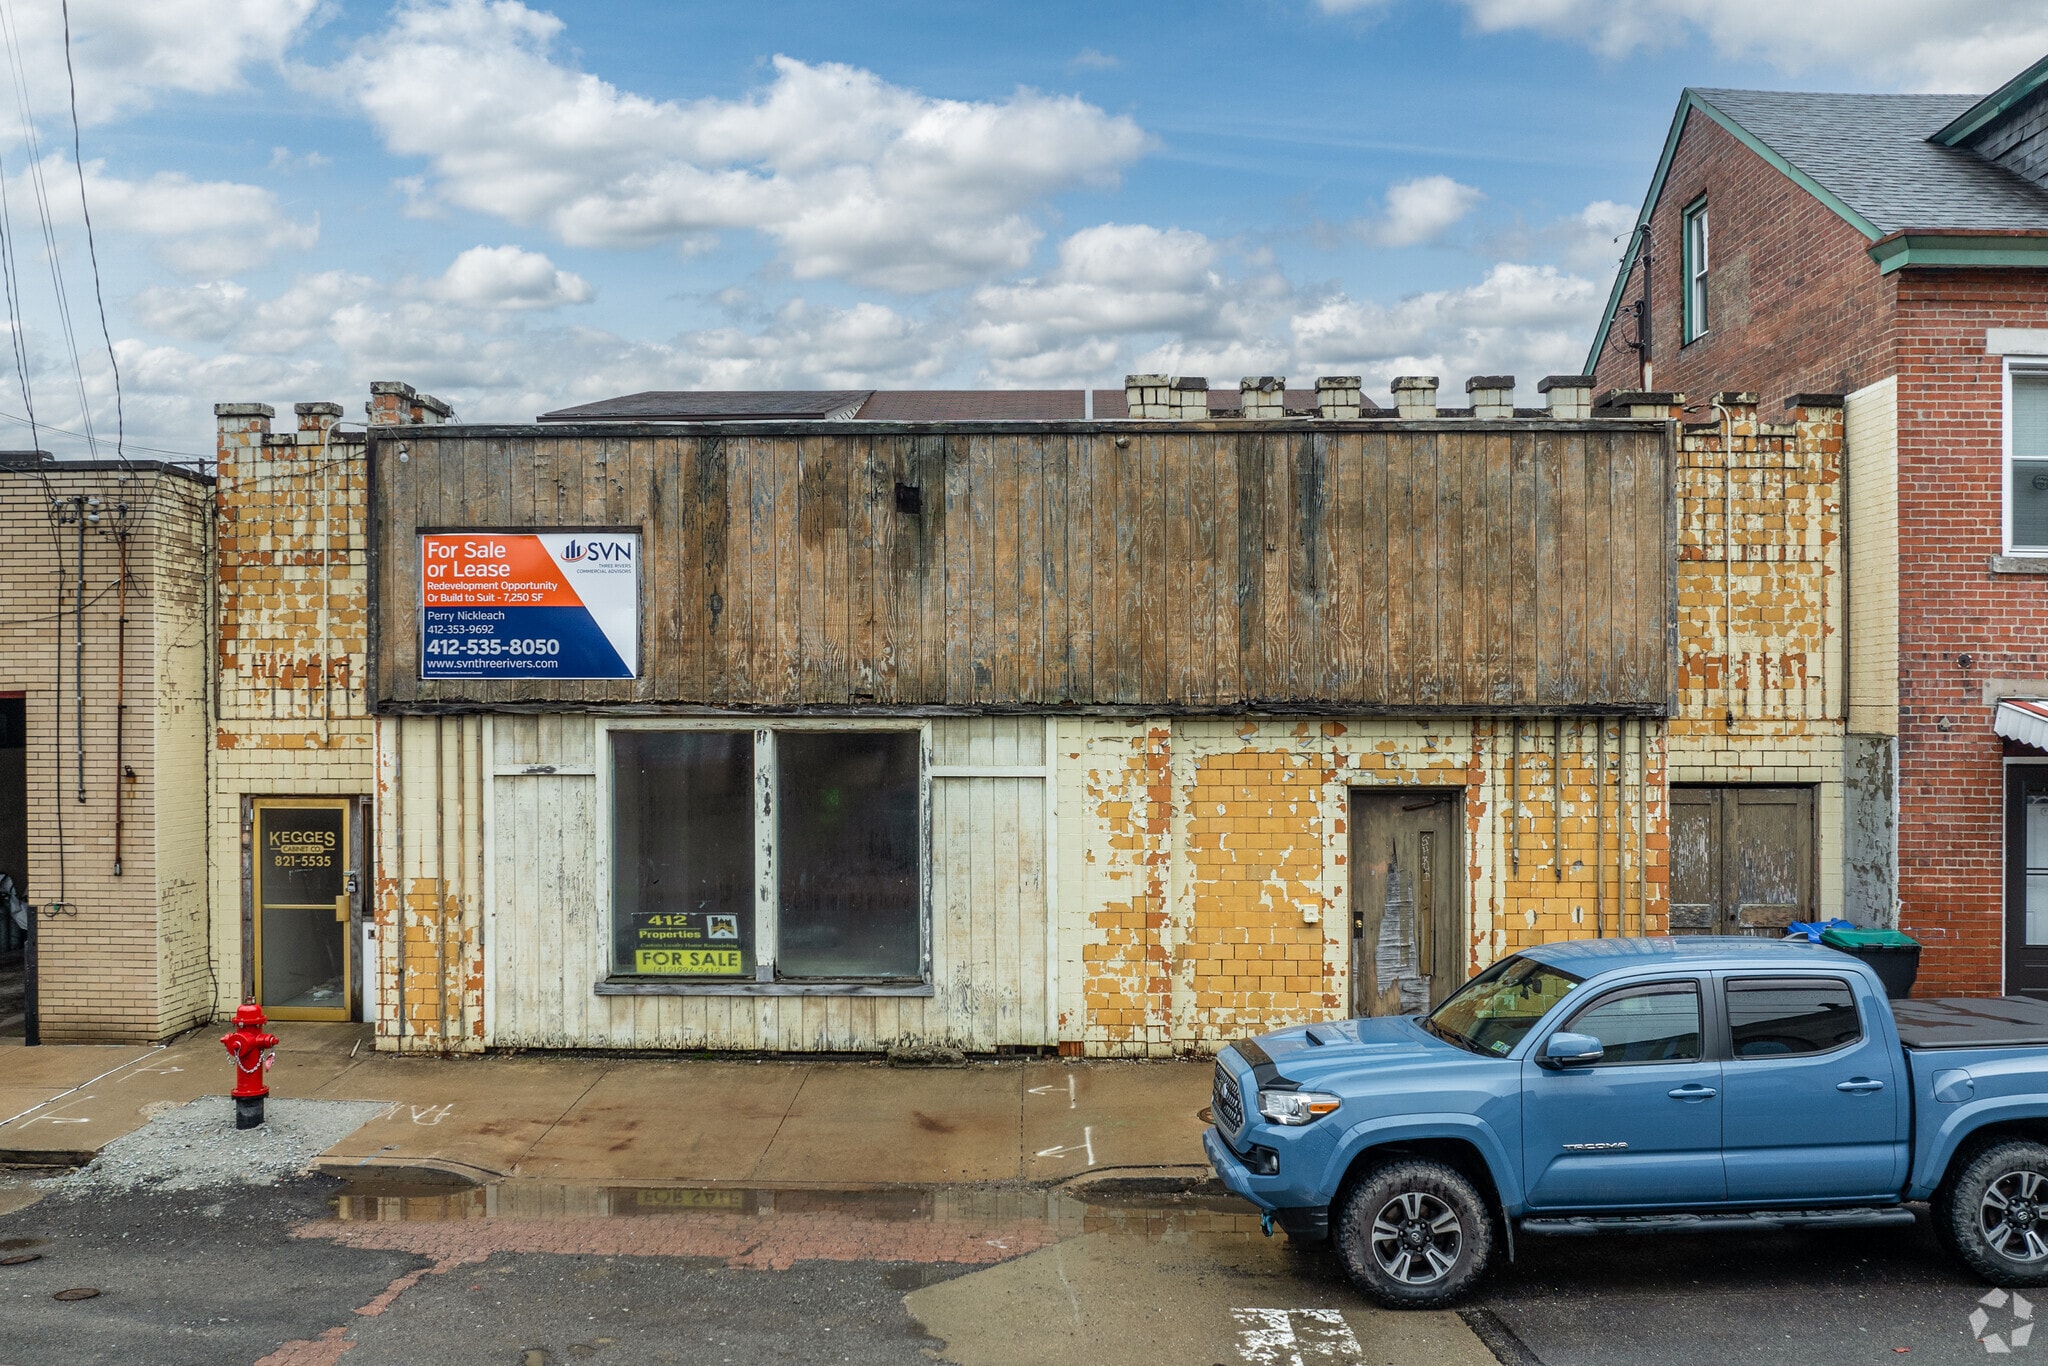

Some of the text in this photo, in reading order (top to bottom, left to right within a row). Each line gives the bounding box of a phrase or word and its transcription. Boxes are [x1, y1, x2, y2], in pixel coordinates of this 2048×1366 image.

[428, 541, 506, 559] For Sale
[588, 542, 631, 560] SVN
[427, 560, 511, 578] or Lease
[427, 581, 558, 592] Redevelopment Opportunity
[427, 593, 438, 602] Or
[440, 593, 463, 602] Build
[465, 594, 475, 602] to
[477, 593, 495, 602] Suit
[503, 593, 530, 603] 7,250
[531, 593, 544, 602] SF
[427, 611, 505, 622] Perry Nickleach
[427, 625, 494, 634] 412-353-9692
[427, 639, 560, 655] 412-535-8050
[427, 658, 558, 668] www.svnthreerivers.com
[269, 831, 336, 846] KEGGES
[274, 855, 332, 867] 821-5535
[648, 914, 688, 926] 412
[639, 930, 702, 940] Properties
[642, 952, 738, 967] FOR SALE
[1562, 1142, 1628, 1150] TACOMA
